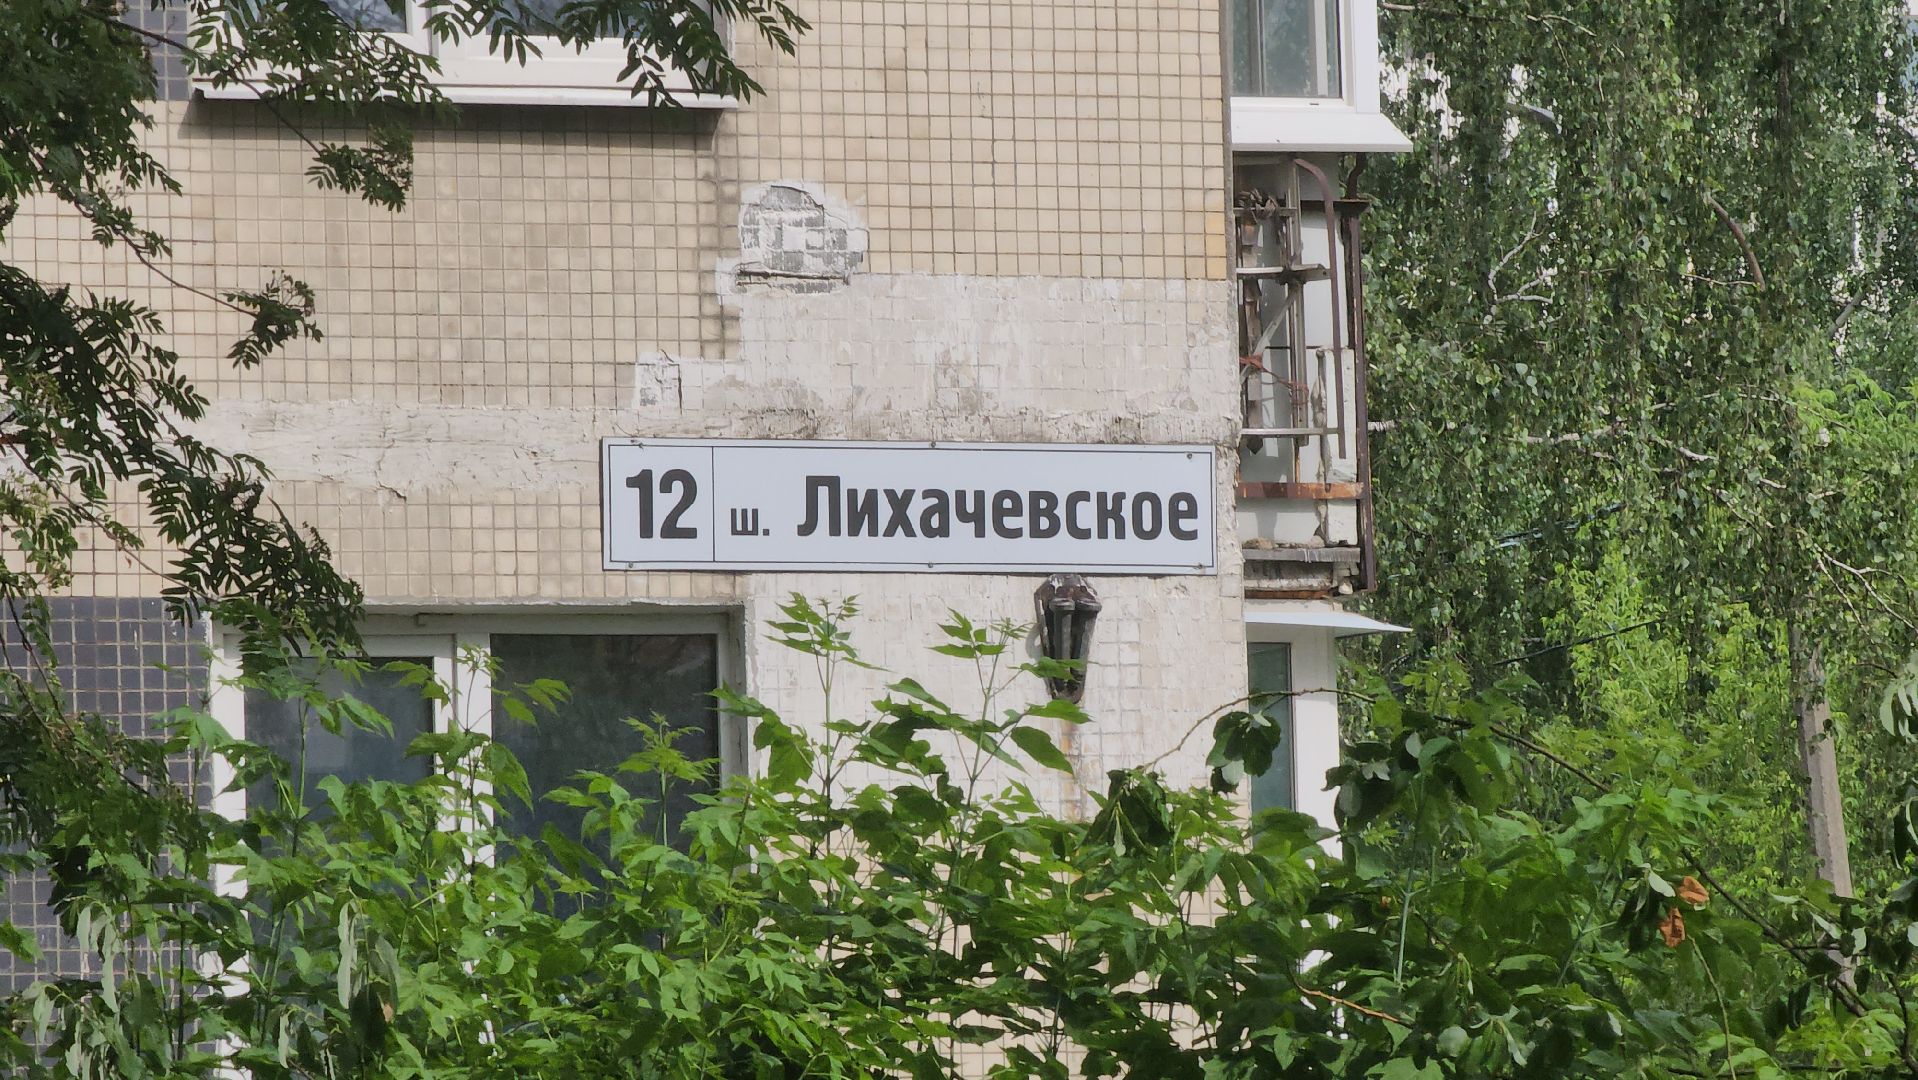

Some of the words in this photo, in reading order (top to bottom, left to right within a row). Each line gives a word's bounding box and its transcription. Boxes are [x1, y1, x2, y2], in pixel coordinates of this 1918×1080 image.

[625, 468, 698, 539] 12
[730, 508, 770, 536] ш.
[797, 475, 1198, 541] Лихачевское
